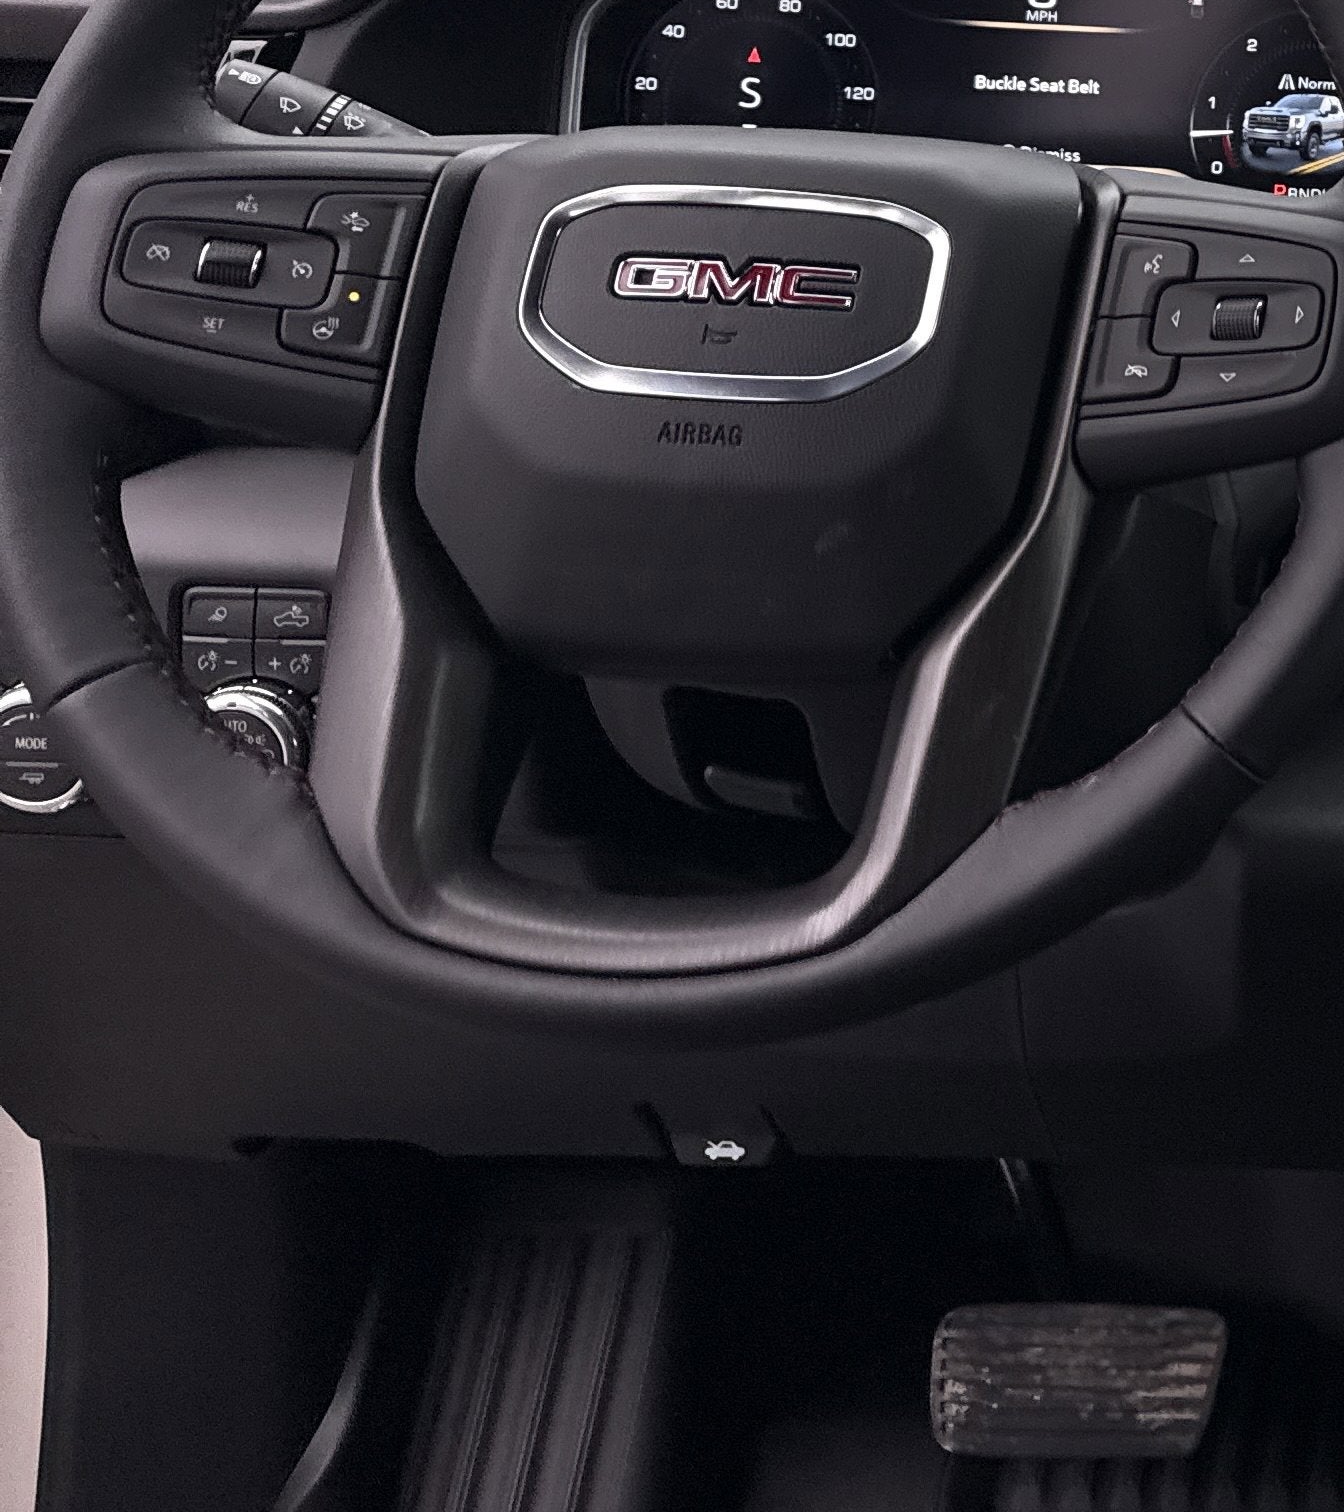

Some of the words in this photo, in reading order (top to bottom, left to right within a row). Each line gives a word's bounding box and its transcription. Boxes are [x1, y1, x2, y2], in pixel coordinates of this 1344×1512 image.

[779, 0, 801, 12] 80
[1026, 10, 1057, 22] MPH
[662, 25, 685, 38] 40
[826, 33, 856, 47] 100
[1247, 39, 1257, 51] 2
[635, 77, 657, 90] 20
[975, 75, 1026, 91] Buckle
[1030, 77, 1065, 93] Seat
[1068, 79, 1100, 94] Belt
[739, 77, 761, 108] S
[844, 87, 874, 100] 120
[1208, 97, 1215, 109] 1
[1211, 161, 1222, 174] 0
[236, 200, 258, 214] RES
[614, 257, 858, 308] GMC
[202, 316, 224, 330] SET
[656, 420, 744, 447] AIRBAG
[223, 719, 247, 733] UTO
[15, 737, 48, 750] MODE
